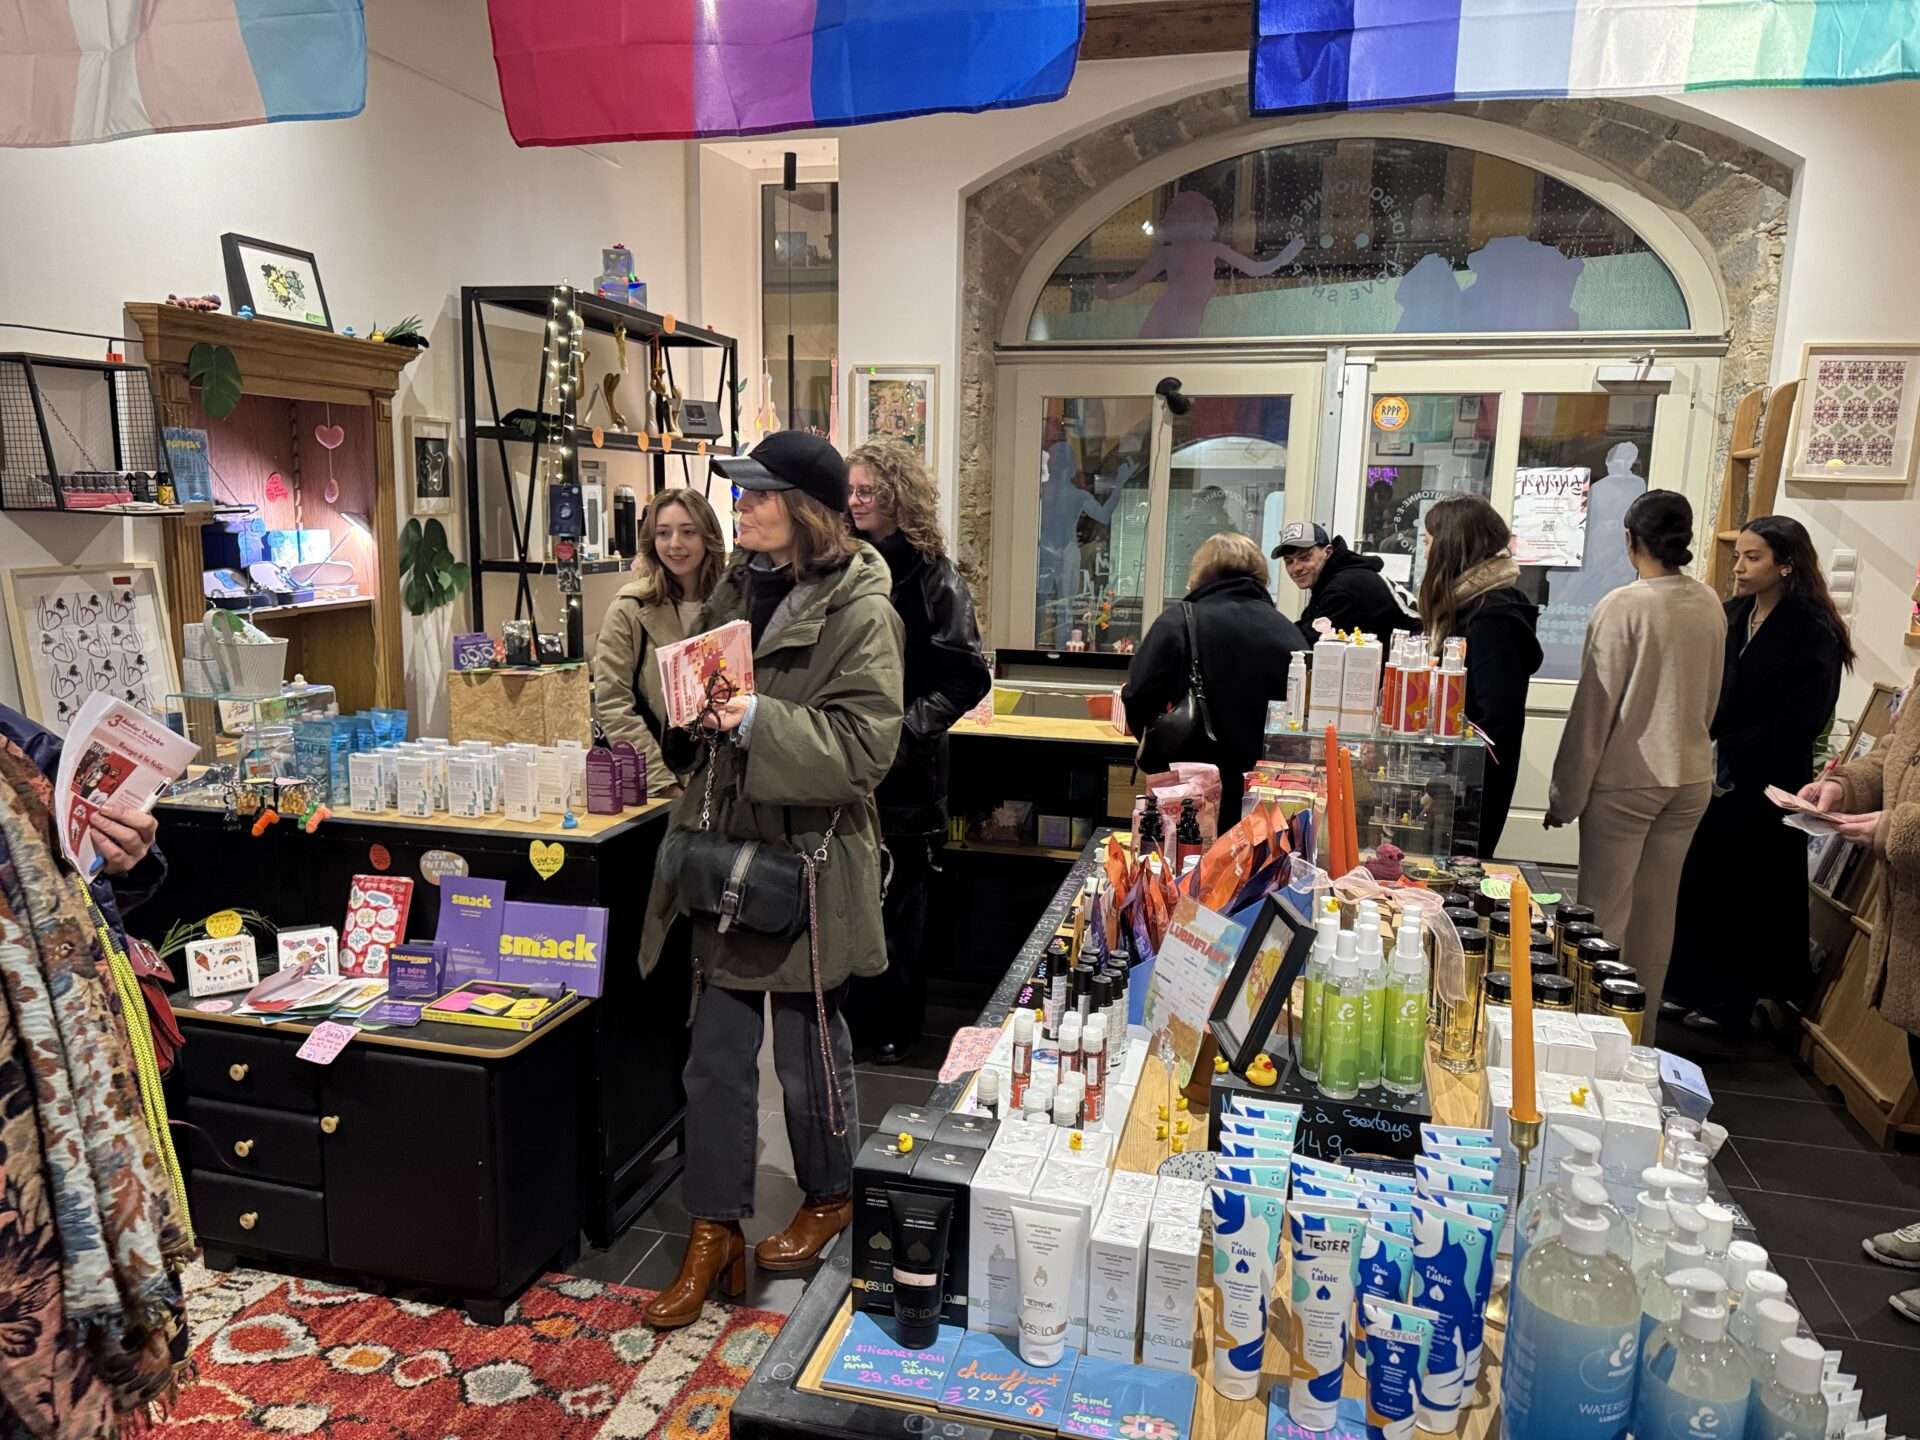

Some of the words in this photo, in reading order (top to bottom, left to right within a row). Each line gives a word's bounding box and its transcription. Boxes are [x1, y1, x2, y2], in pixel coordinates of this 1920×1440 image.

[452, 893, 492, 909] smack
[499, 934, 597, 962] smack
[1305, 1233, 1351, 1253] TESTER
[1231, 1246, 1257, 1258] Lubie
[1311, 1272, 1339, 1283] Lubie
[1426, 1270, 1454, 1286] Lubie
[967, 1386, 1028, 1406] 29.90
